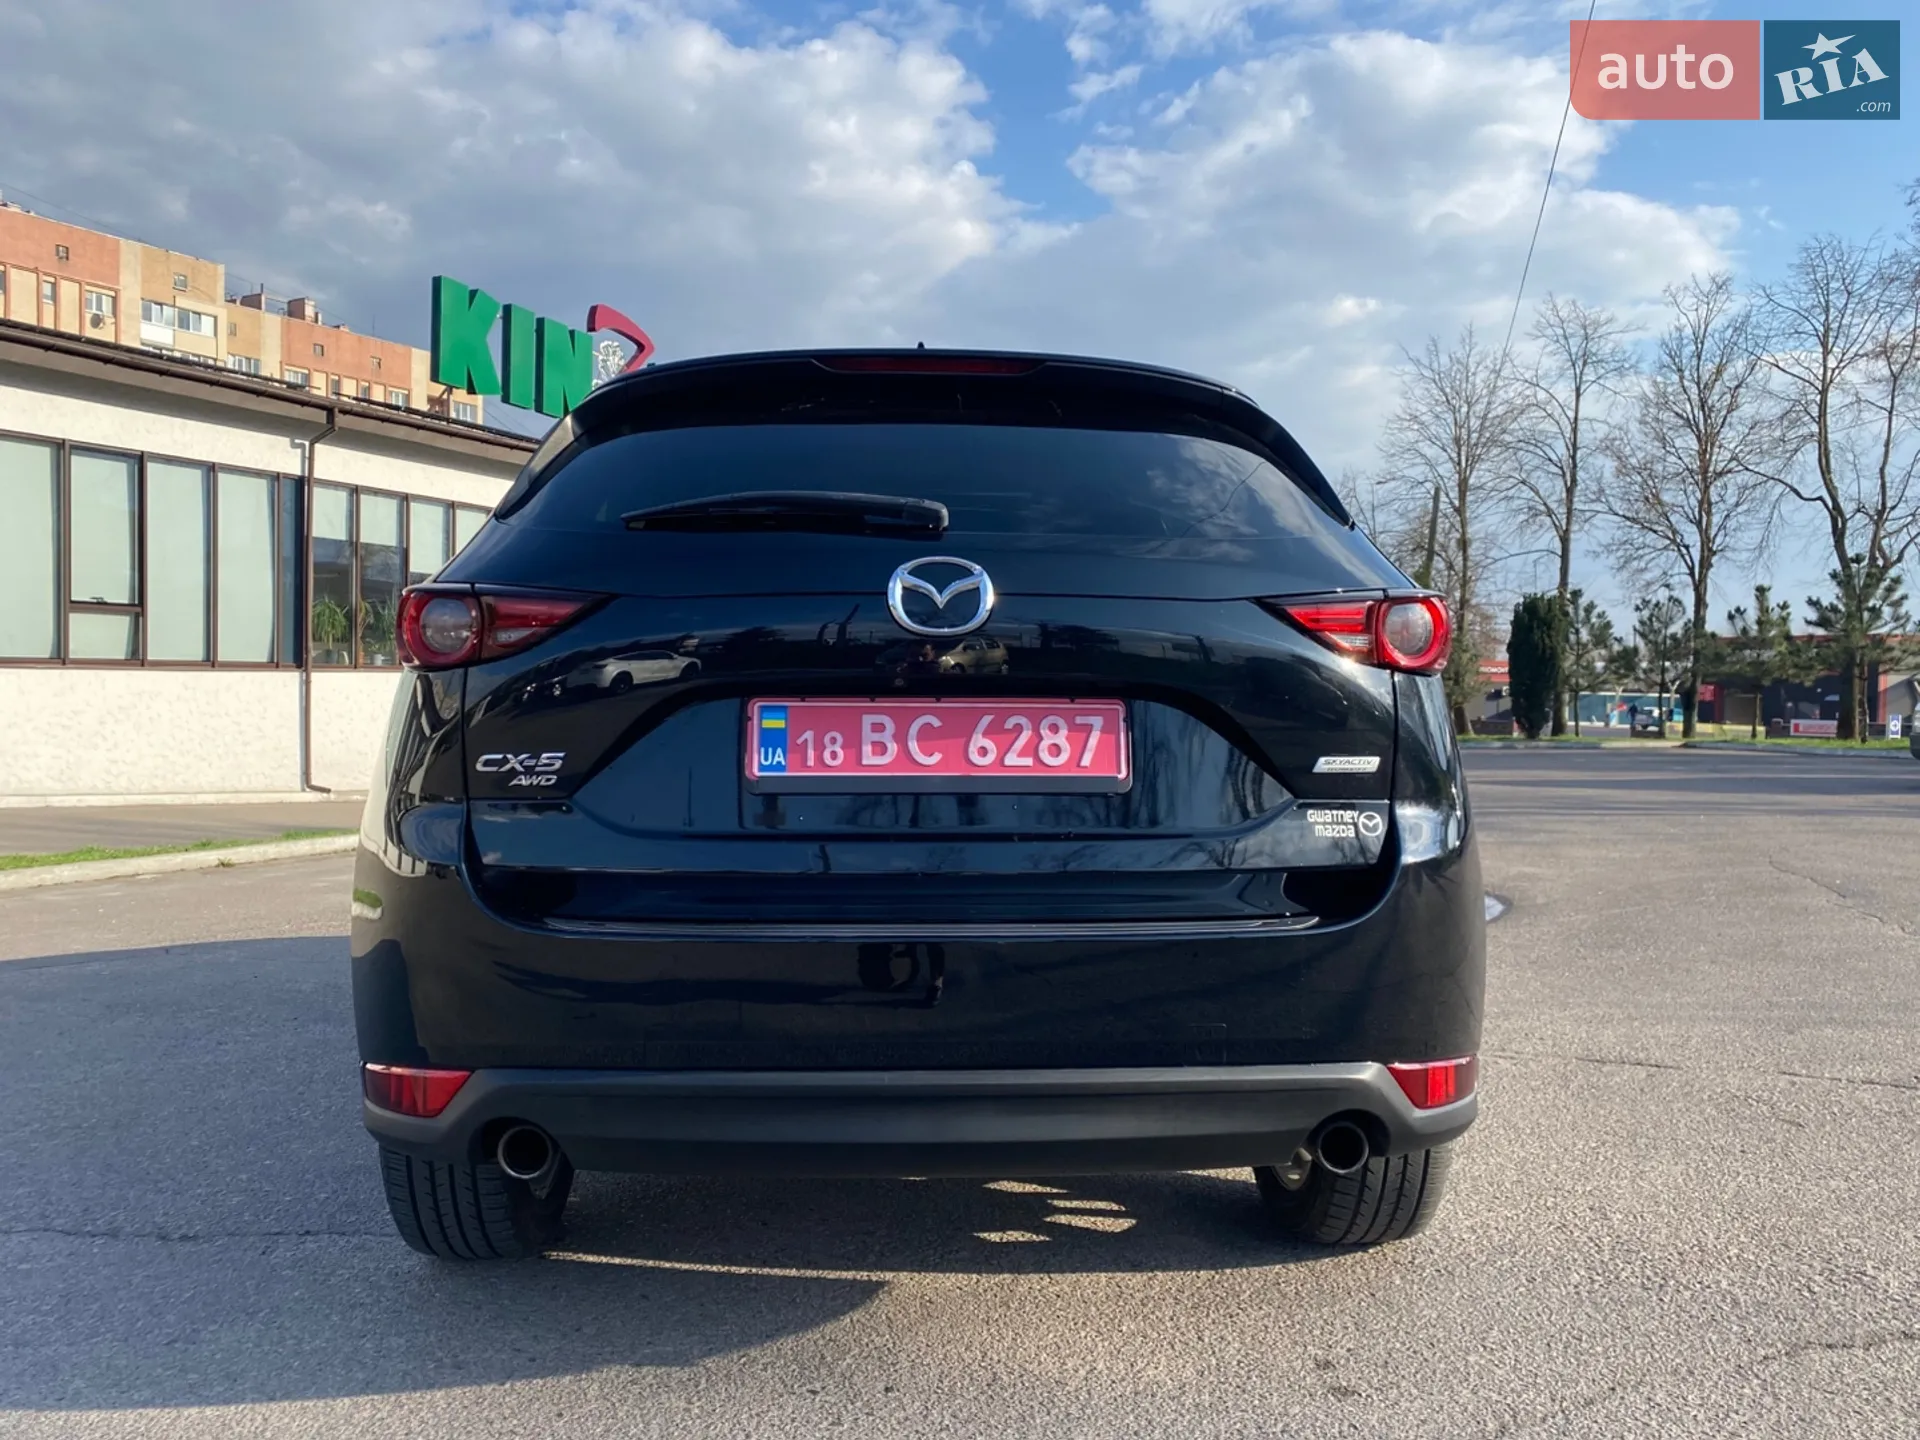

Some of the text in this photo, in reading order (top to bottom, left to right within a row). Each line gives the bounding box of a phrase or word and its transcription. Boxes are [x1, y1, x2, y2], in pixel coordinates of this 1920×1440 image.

[760, 714, 1105, 768] UA 18 BC 6287
[475, 752, 566, 772] CX-5
[1322, 758, 1374, 766] SKYACTIV
[508, 774, 558, 787] AWD
